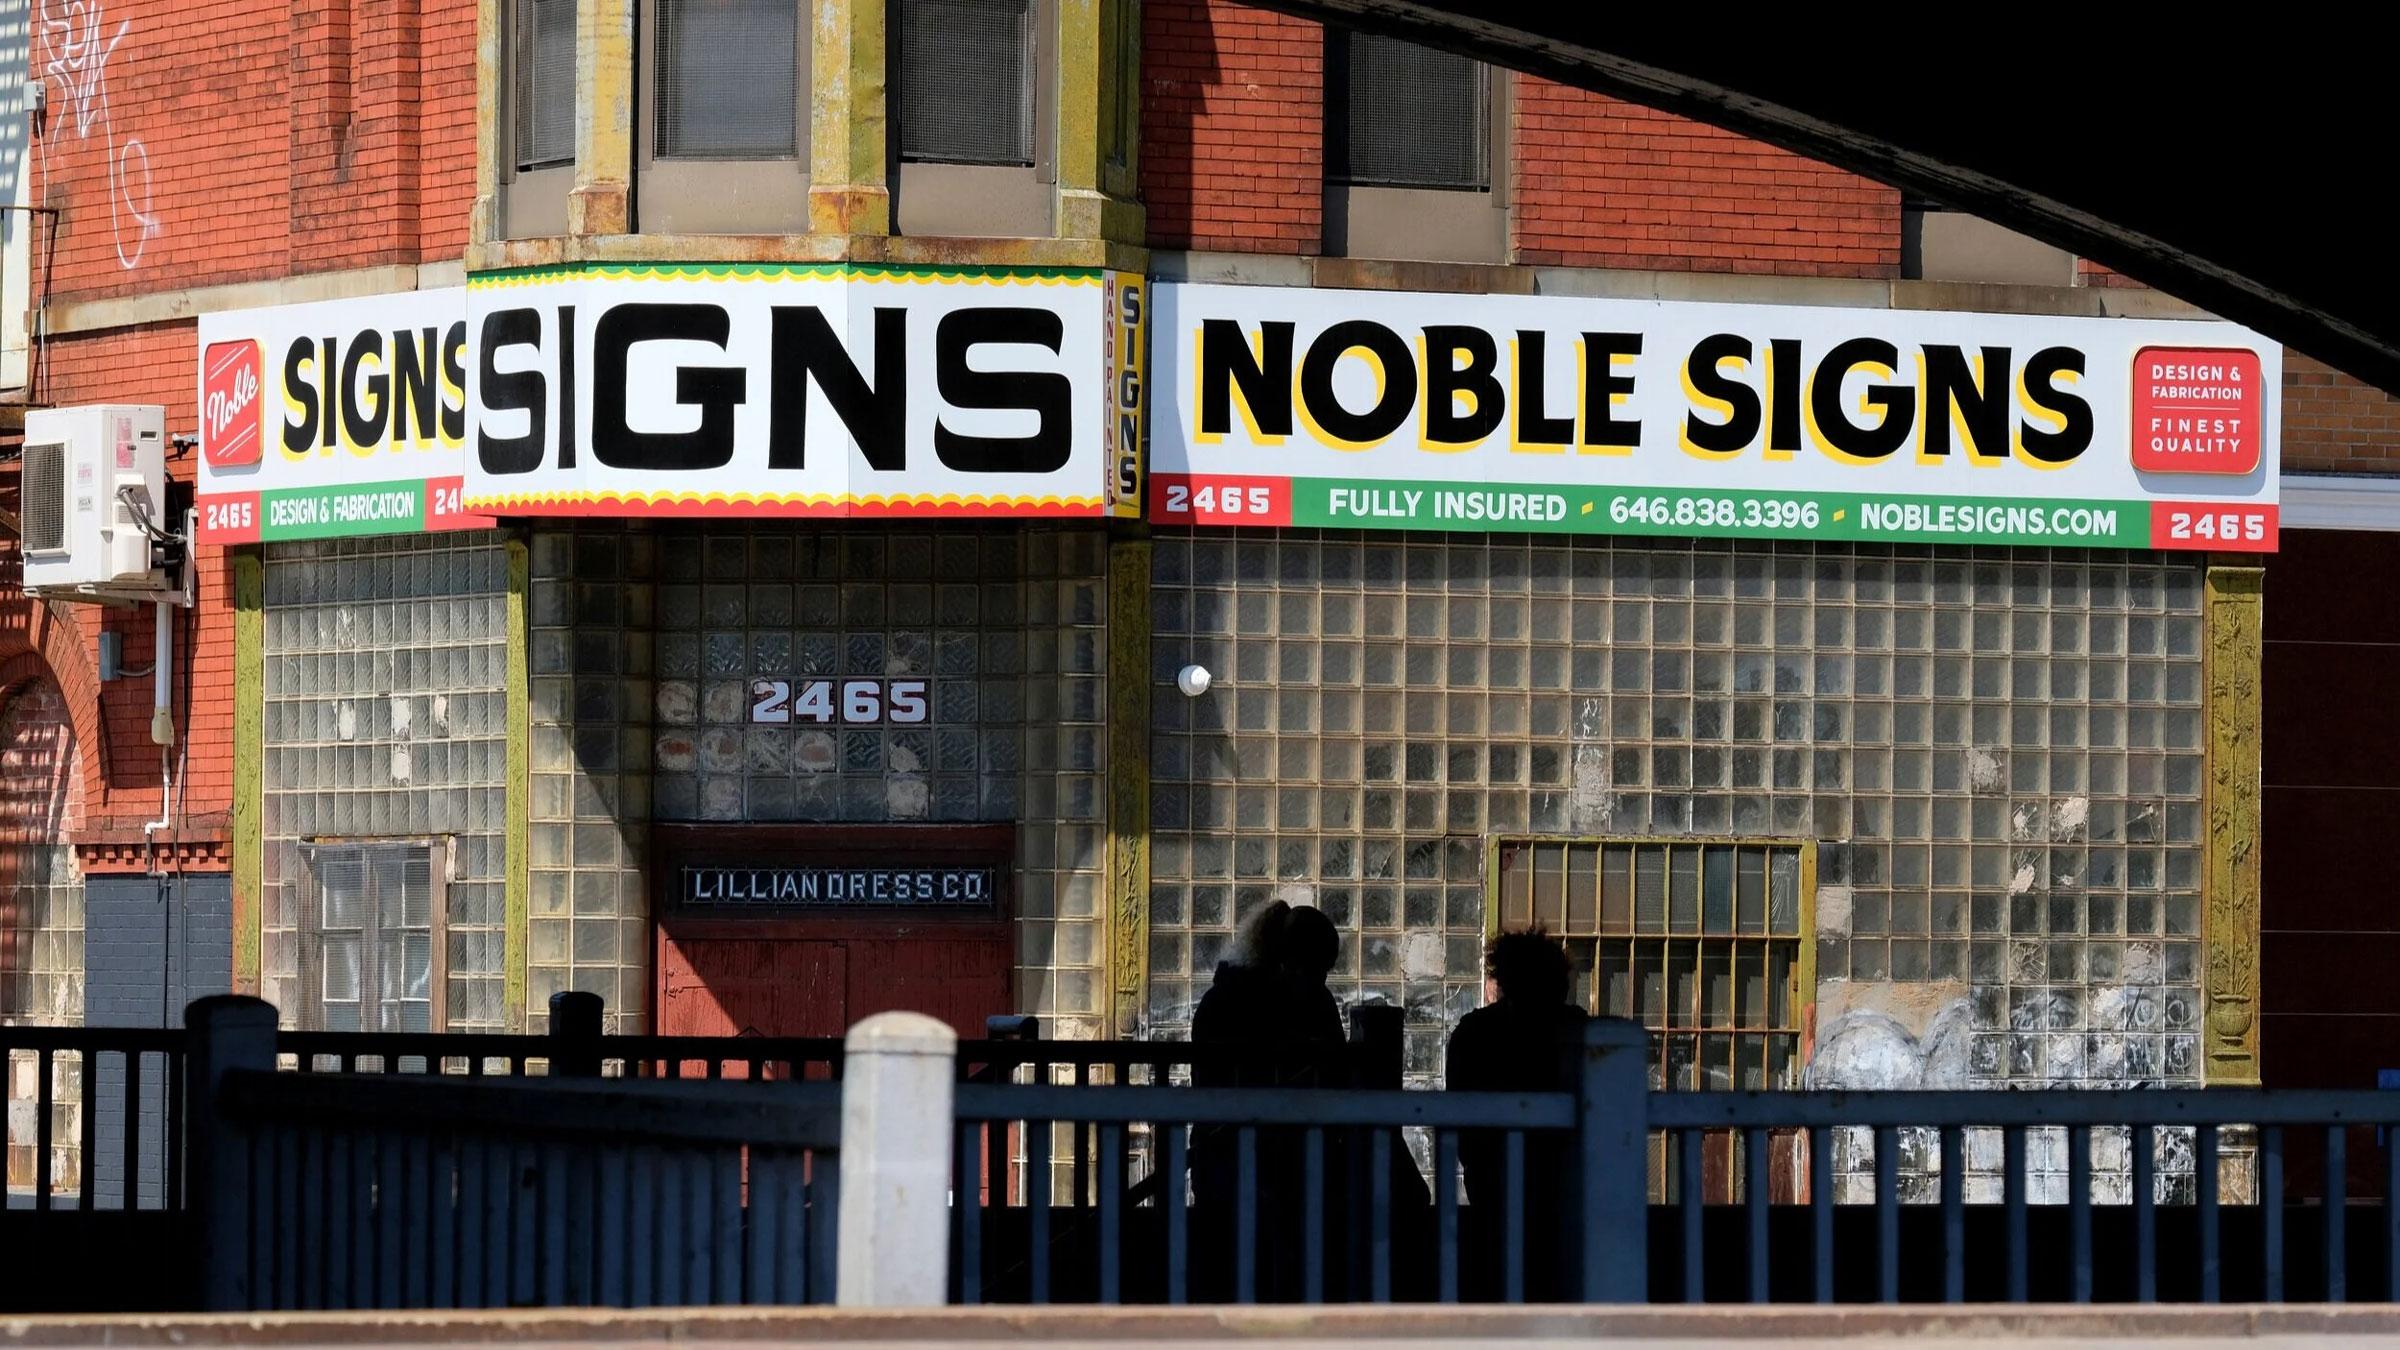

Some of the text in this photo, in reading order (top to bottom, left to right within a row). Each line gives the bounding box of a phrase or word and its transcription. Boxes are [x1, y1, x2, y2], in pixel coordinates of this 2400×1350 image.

[477, 302, 1072, 475] SIGNS
[2151, 364, 2241, 382] DESIGN &
[207, 363, 259, 441] Noble
[280, 320, 466, 462] SIGNS
[1107, 279, 1115, 507] HAND PAINTED
[1120, 285, 1141, 495] SIGNS
[1194, 319, 2094, 470] NOBLE SIGNS
[2151, 385, 2243, 400] FABRICATION
[2151, 418, 2241, 434] FINEST
[2150, 437, 2241, 453] QUALITY
[207, 501, 252, 531] 2465
[270, 490, 415, 527] DESIGN & FABRICATION
[434, 487, 464, 516] 24
[1166, 485, 1270, 515] 2465
[1329, 487, 2118, 537] FULLY INSURED 646.838.3396 NOBLESIGNS.COM
[2170, 512, 2265, 541] 2465
[752, 680, 926, 723] 2465
[695, 873, 989, 899] LILLIAN DRESS CO.
